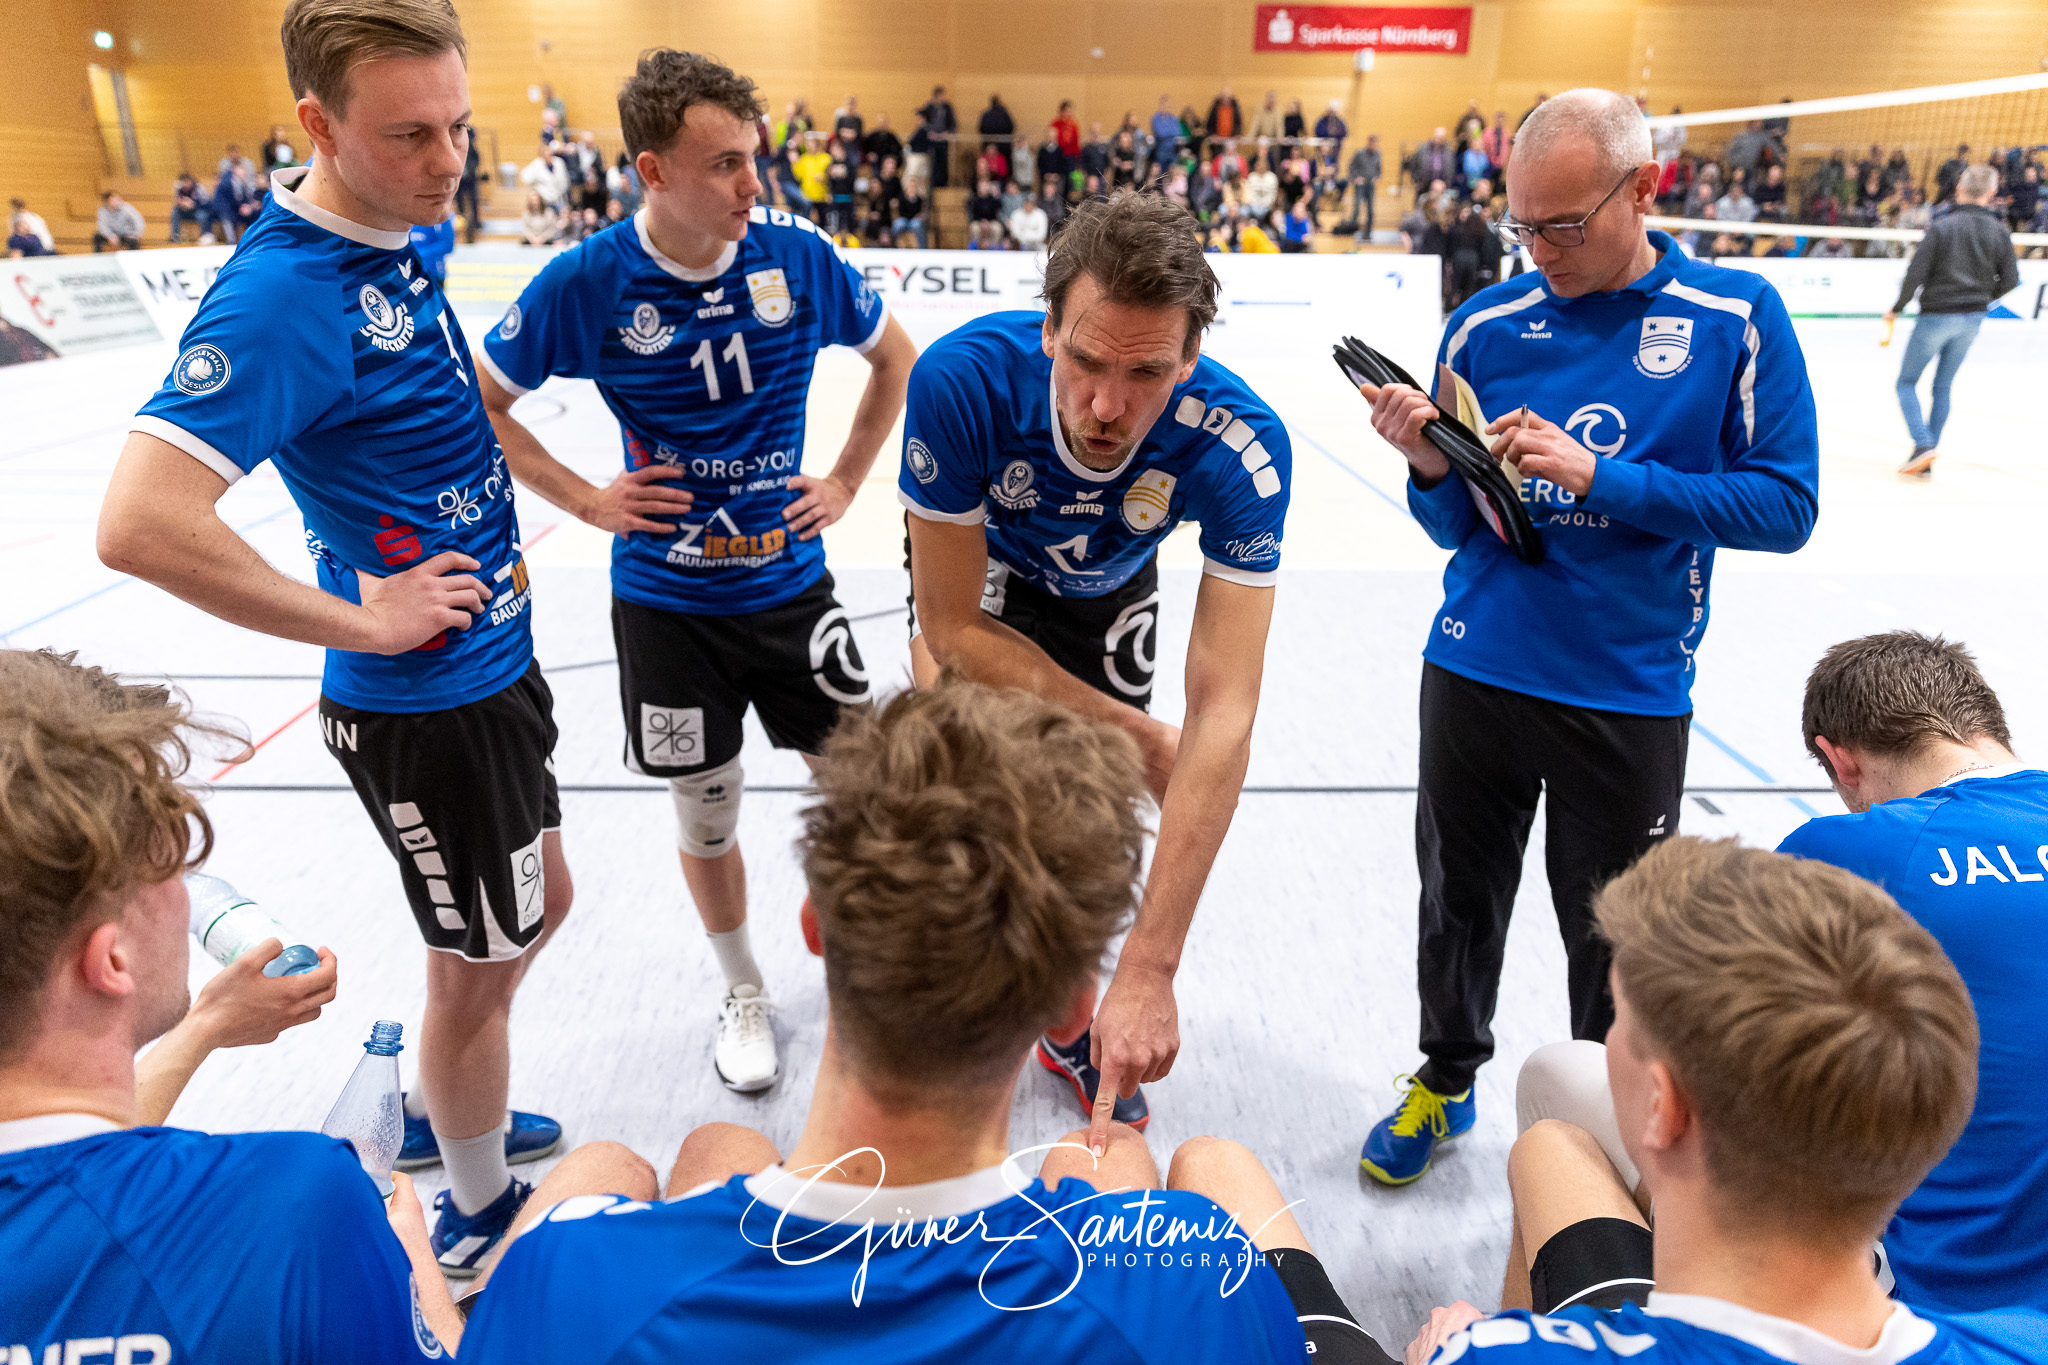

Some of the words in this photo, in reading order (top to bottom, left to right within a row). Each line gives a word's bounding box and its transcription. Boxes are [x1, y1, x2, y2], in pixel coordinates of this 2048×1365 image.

[1300, 24, 1380, 47] Sparkasse
[697, 304, 734, 319] erima
[371, 315, 415, 352] MECKATZER
[1520, 331, 1553, 339] erima
[185, 350, 223, 373] VOLLEYBALL
[690, 332, 754, 400] 11
[691, 447, 796, 479] ORG-YOU
[1060, 502, 1104, 516] erima
[1550, 512, 1610, 528] POOLS
[1442, 616, 1466, 640] CO
